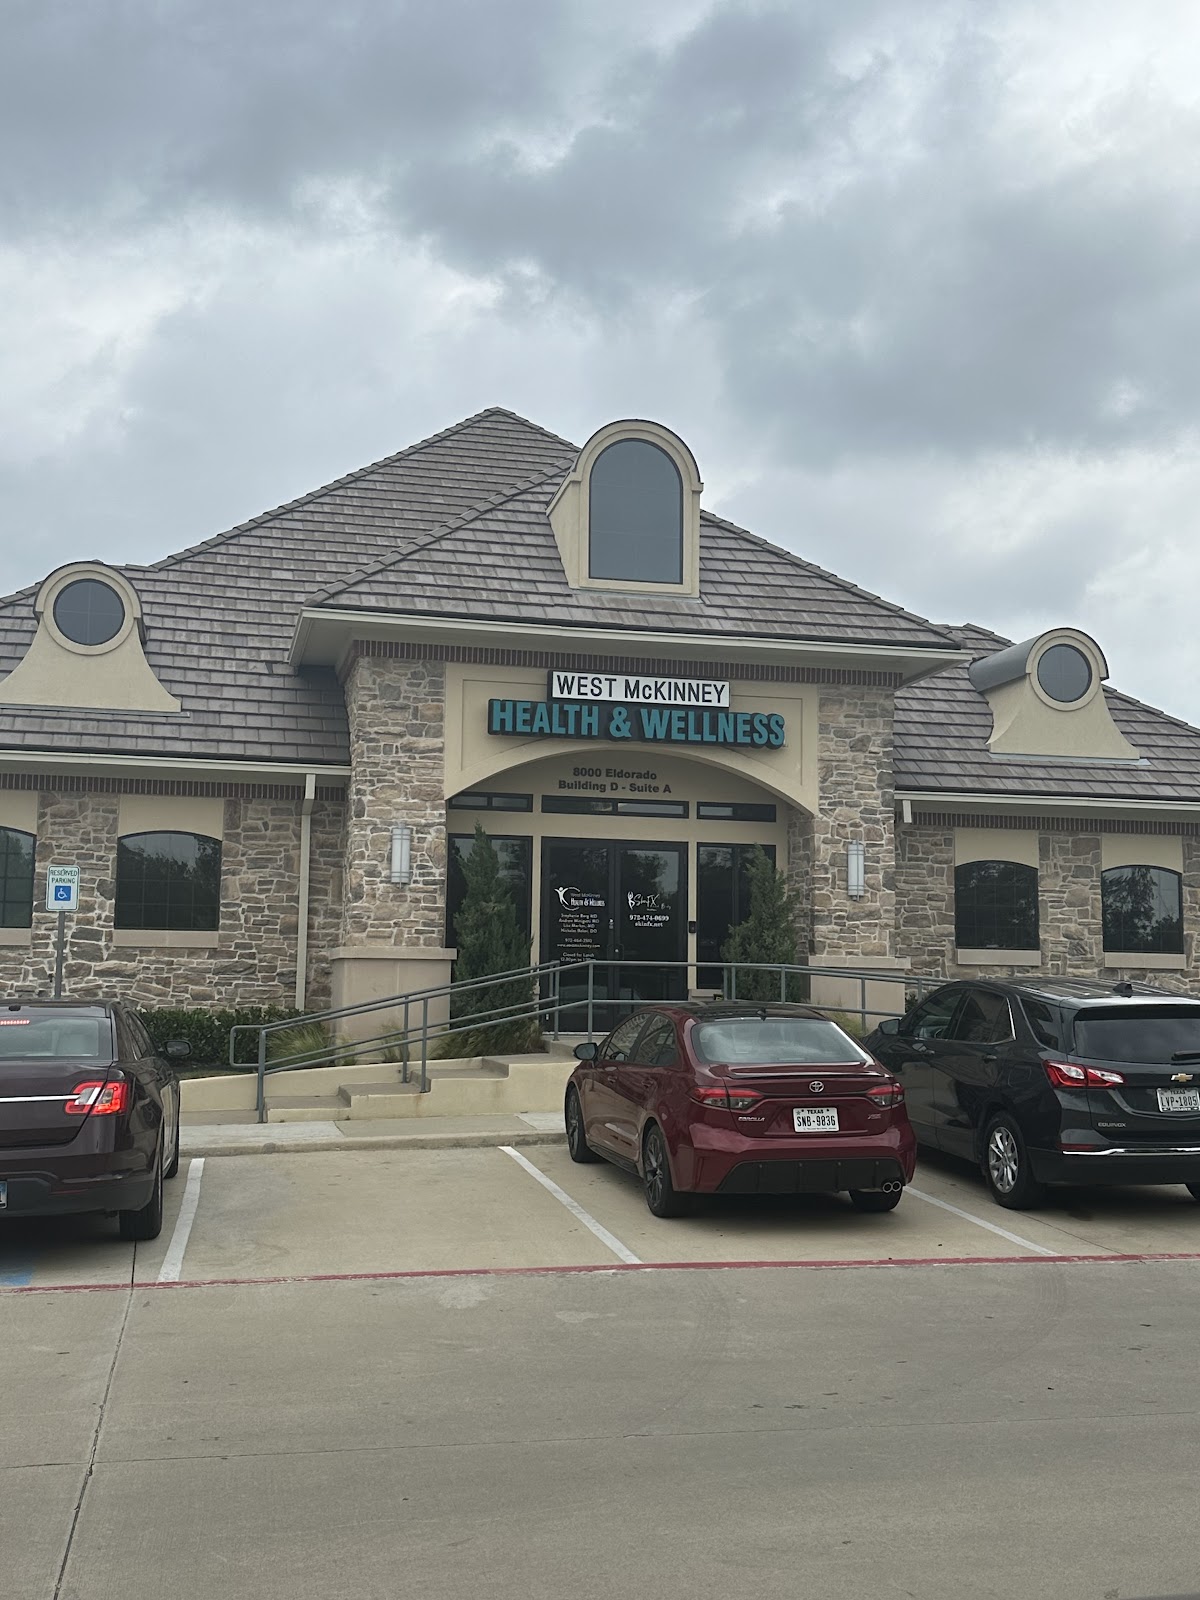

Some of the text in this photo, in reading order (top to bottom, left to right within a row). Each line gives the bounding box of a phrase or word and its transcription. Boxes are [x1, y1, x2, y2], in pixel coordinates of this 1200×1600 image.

[556, 674, 726, 704] WEST McKINNEY
[491, 700, 785, 746] HEALTH & WELLNESS
[572, 767, 657, 780] 8000 Eldorado
[558, 780, 606, 793] Building
[610, 781, 619, 791] D
[629, 782, 660, 793] Suite
[663, 784, 672, 793] A
[50, 869, 77, 877] RESERVED
